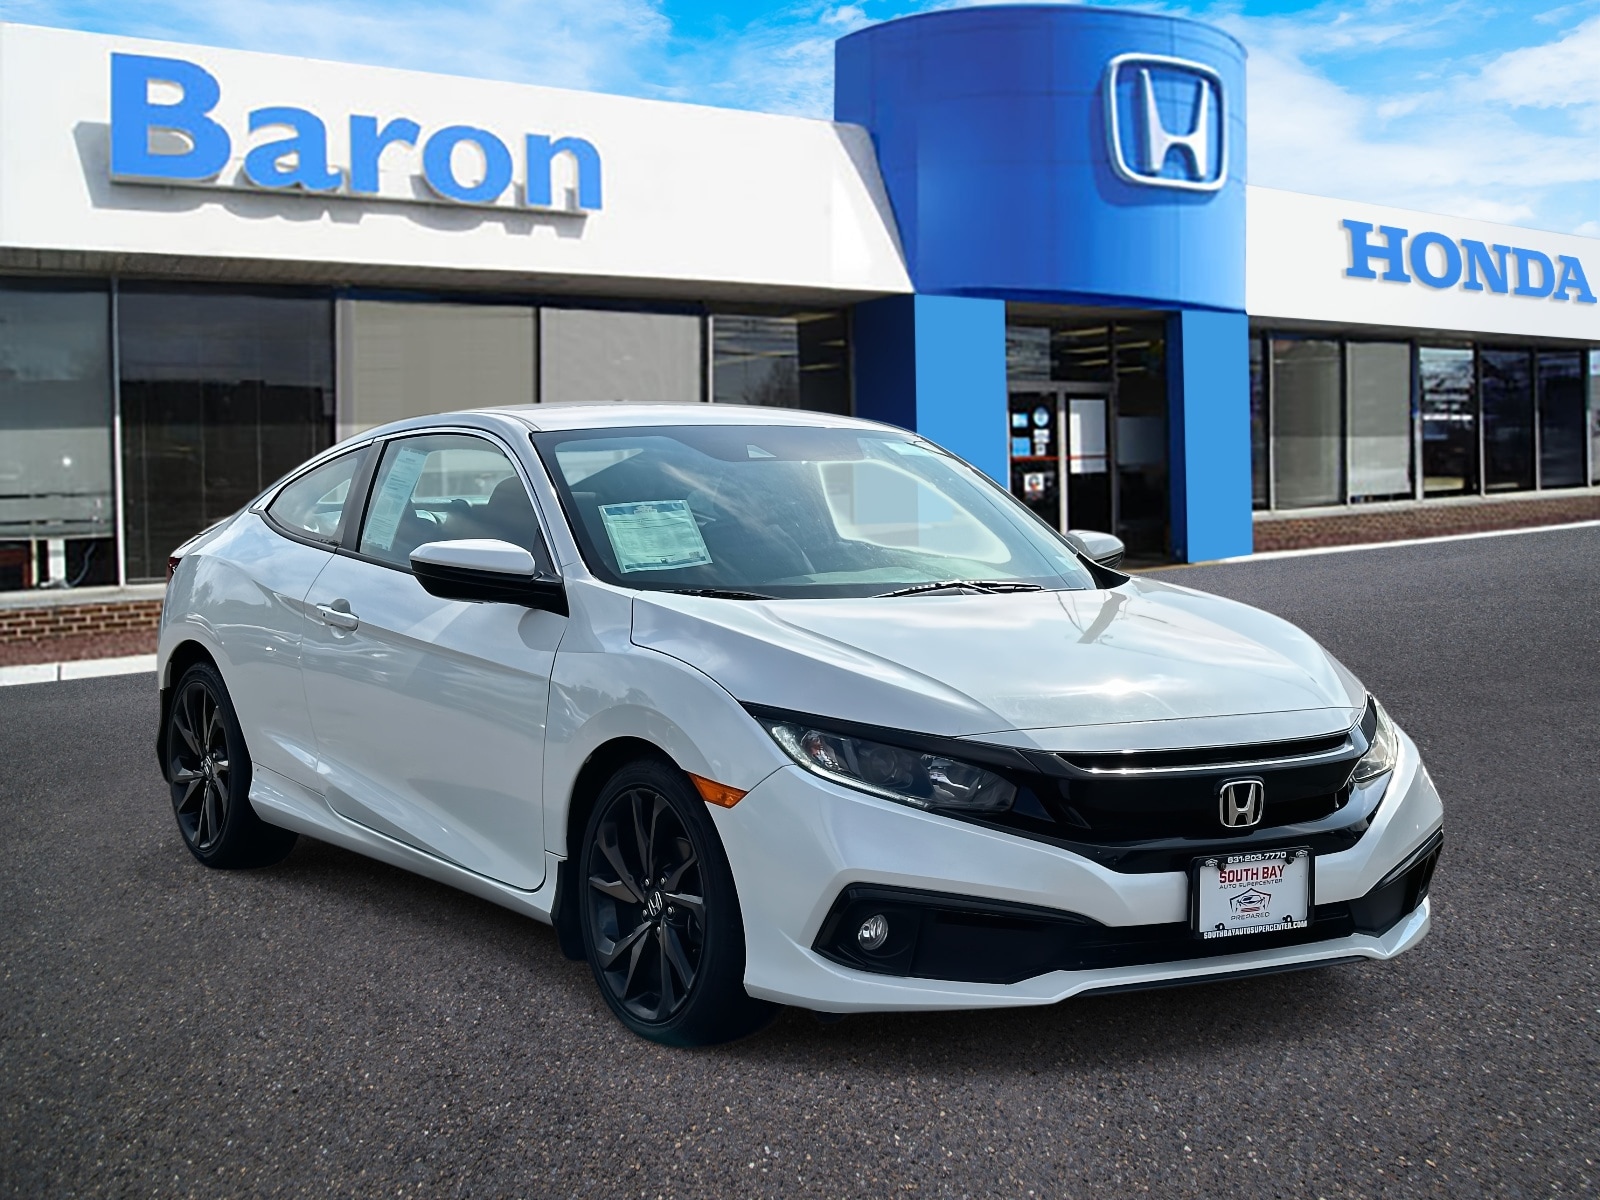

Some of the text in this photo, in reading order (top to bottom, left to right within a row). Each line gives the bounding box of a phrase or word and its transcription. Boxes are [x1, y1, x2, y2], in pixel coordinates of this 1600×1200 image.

[110, 51, 603, 210] Baron
[1342, 218, 1598, 304] HONDA
[1219, 864, 1285, 883] SOUTH BAY
[1238, 879, 1283, 888] SUPERCENTER
[1230, 911, 1270, 921] PREPARED
